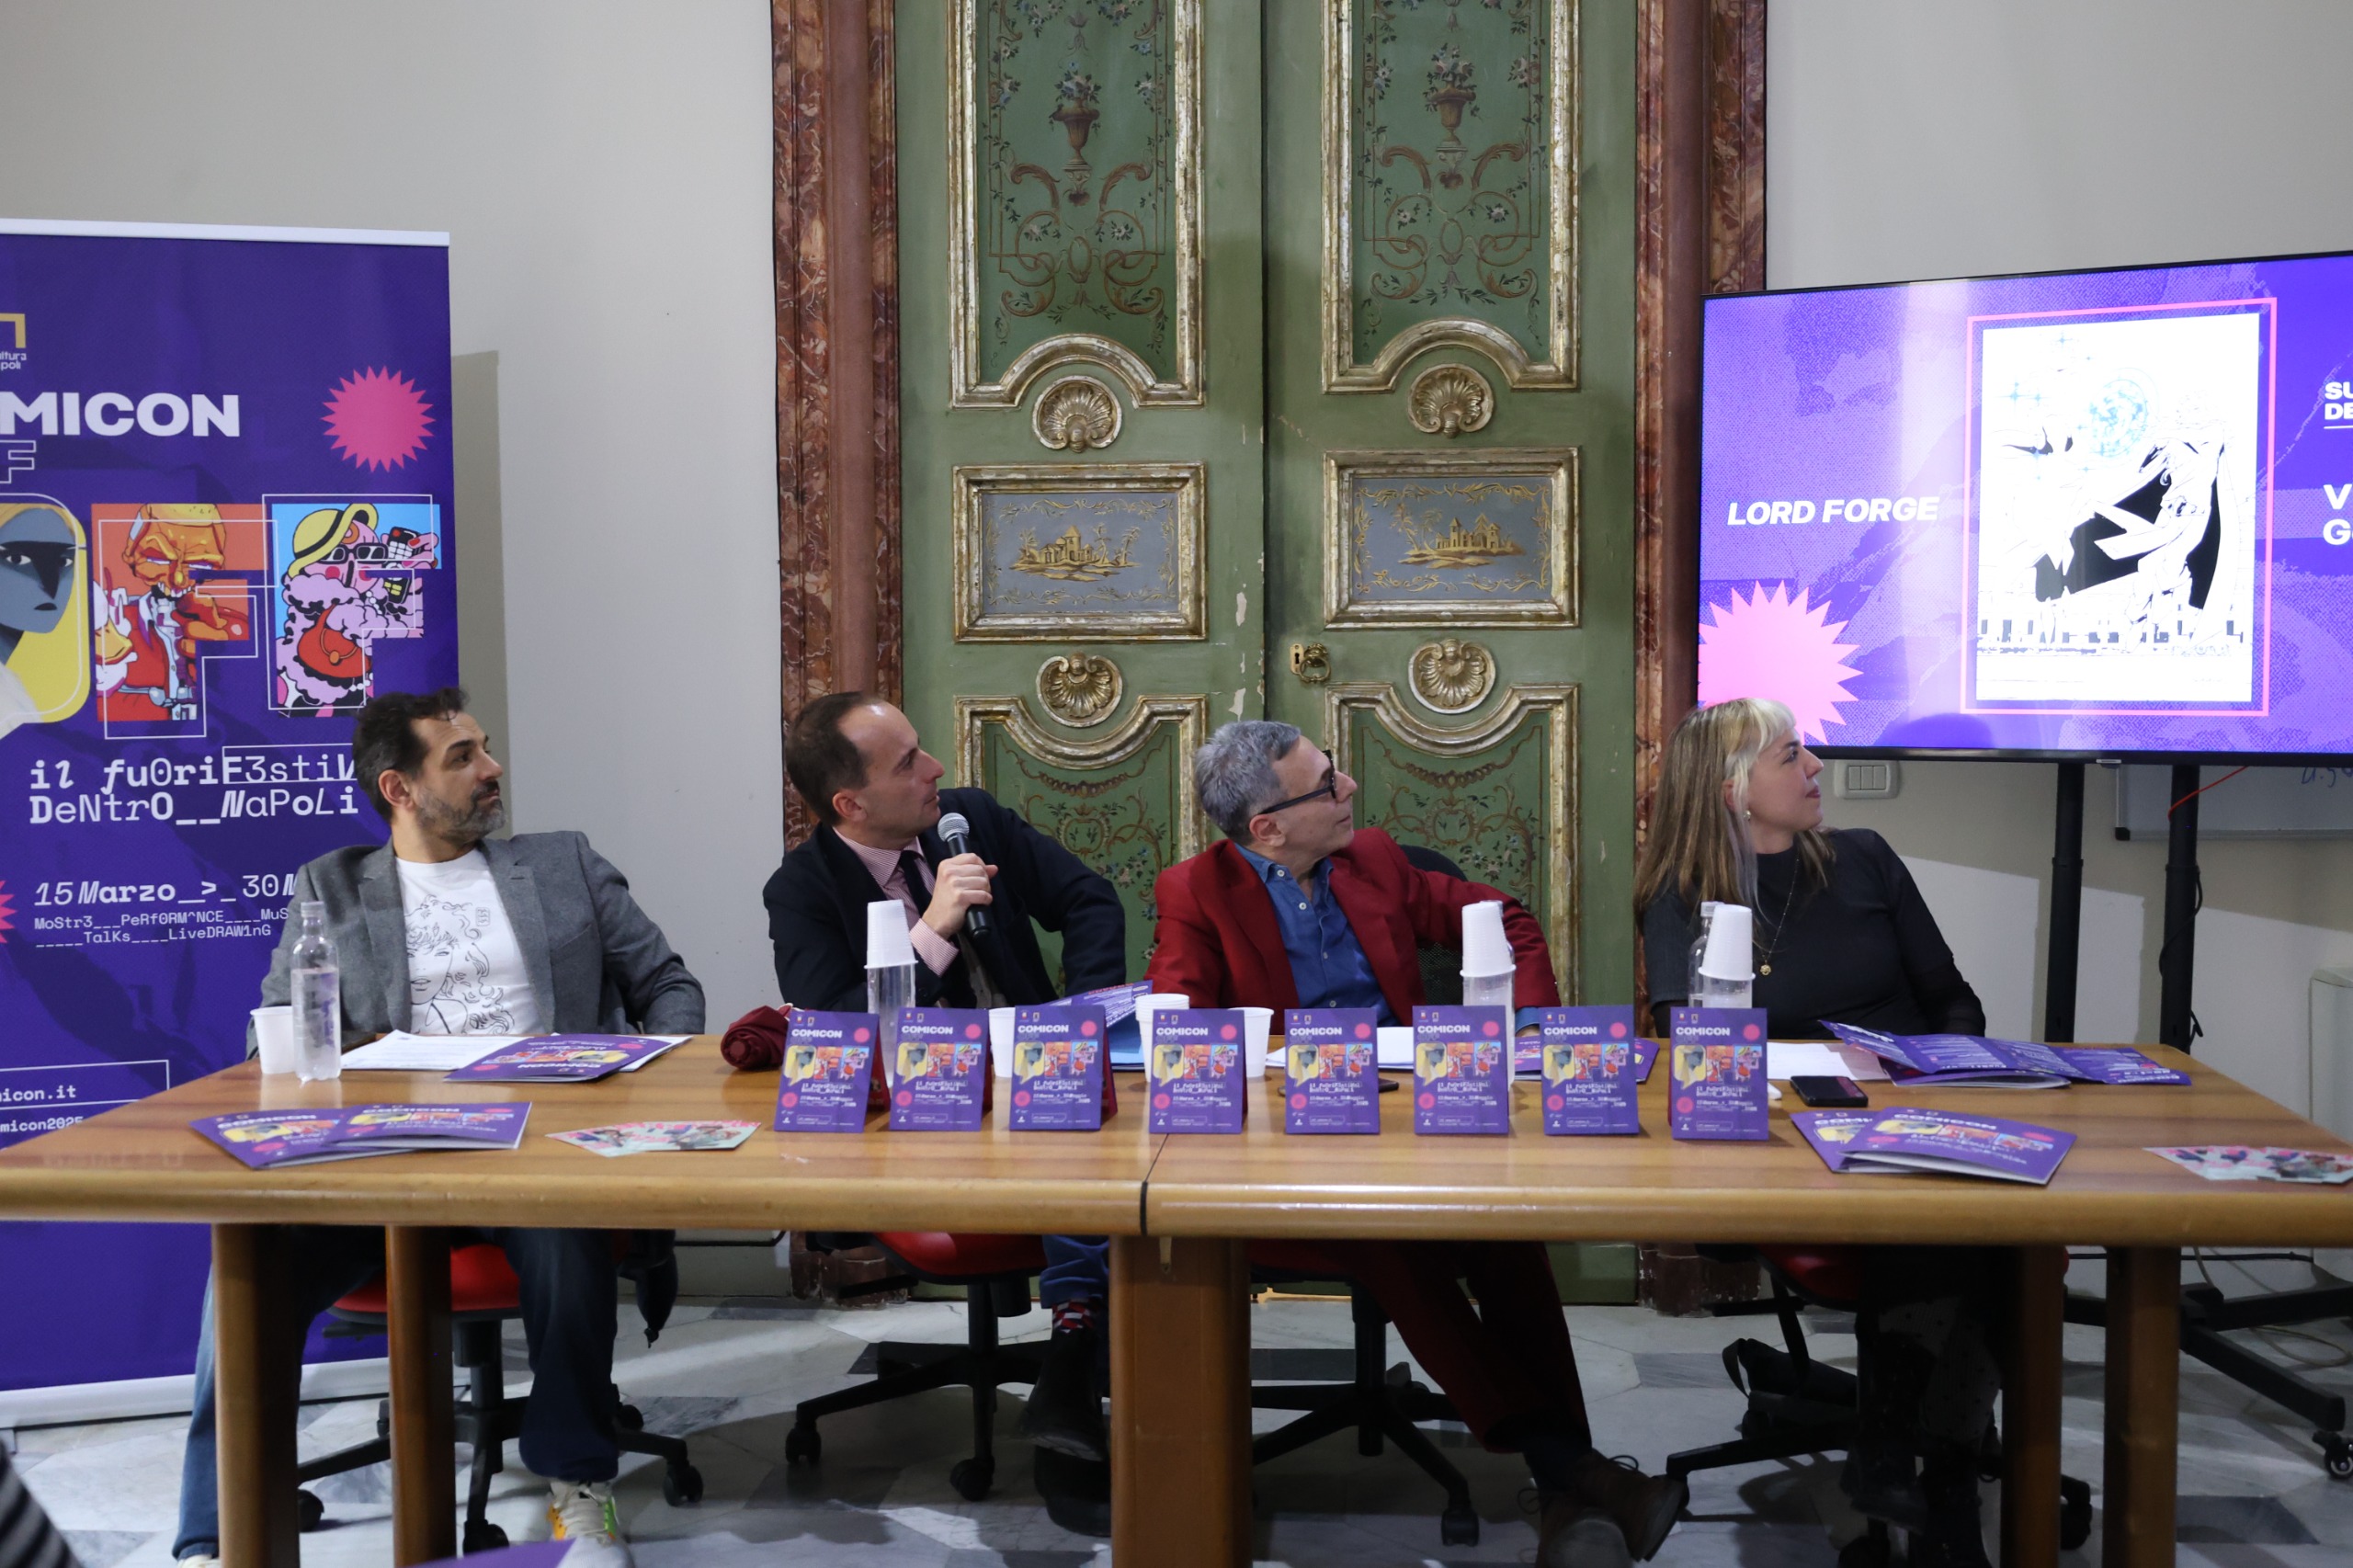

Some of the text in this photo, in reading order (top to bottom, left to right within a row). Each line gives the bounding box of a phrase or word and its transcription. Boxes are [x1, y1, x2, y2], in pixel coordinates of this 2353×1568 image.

[0, 392, 240, 437] MICON
[1727, 496, 1939, 525] LORD FORGE
[2323, 518, 2353, 546] G
[29, 760, 74, 790] il
[792, 1028, 842, 1039] COMICON
[902, 1025, 953, 1035] COMICON
[1018, 1024, 1069, 1034] COMICON
[1156, 1027, 1208, 1036] COMICON
[1290, 1027, 1342, 1037] COMICON
[1417, 1025, 1470, 1034] COMICON
[1544, 1027, 1597, 1036] COMICON
[1676, 1027, 1730, 1036] COMICON
[0, 1085, 76, 1103] icon.it
